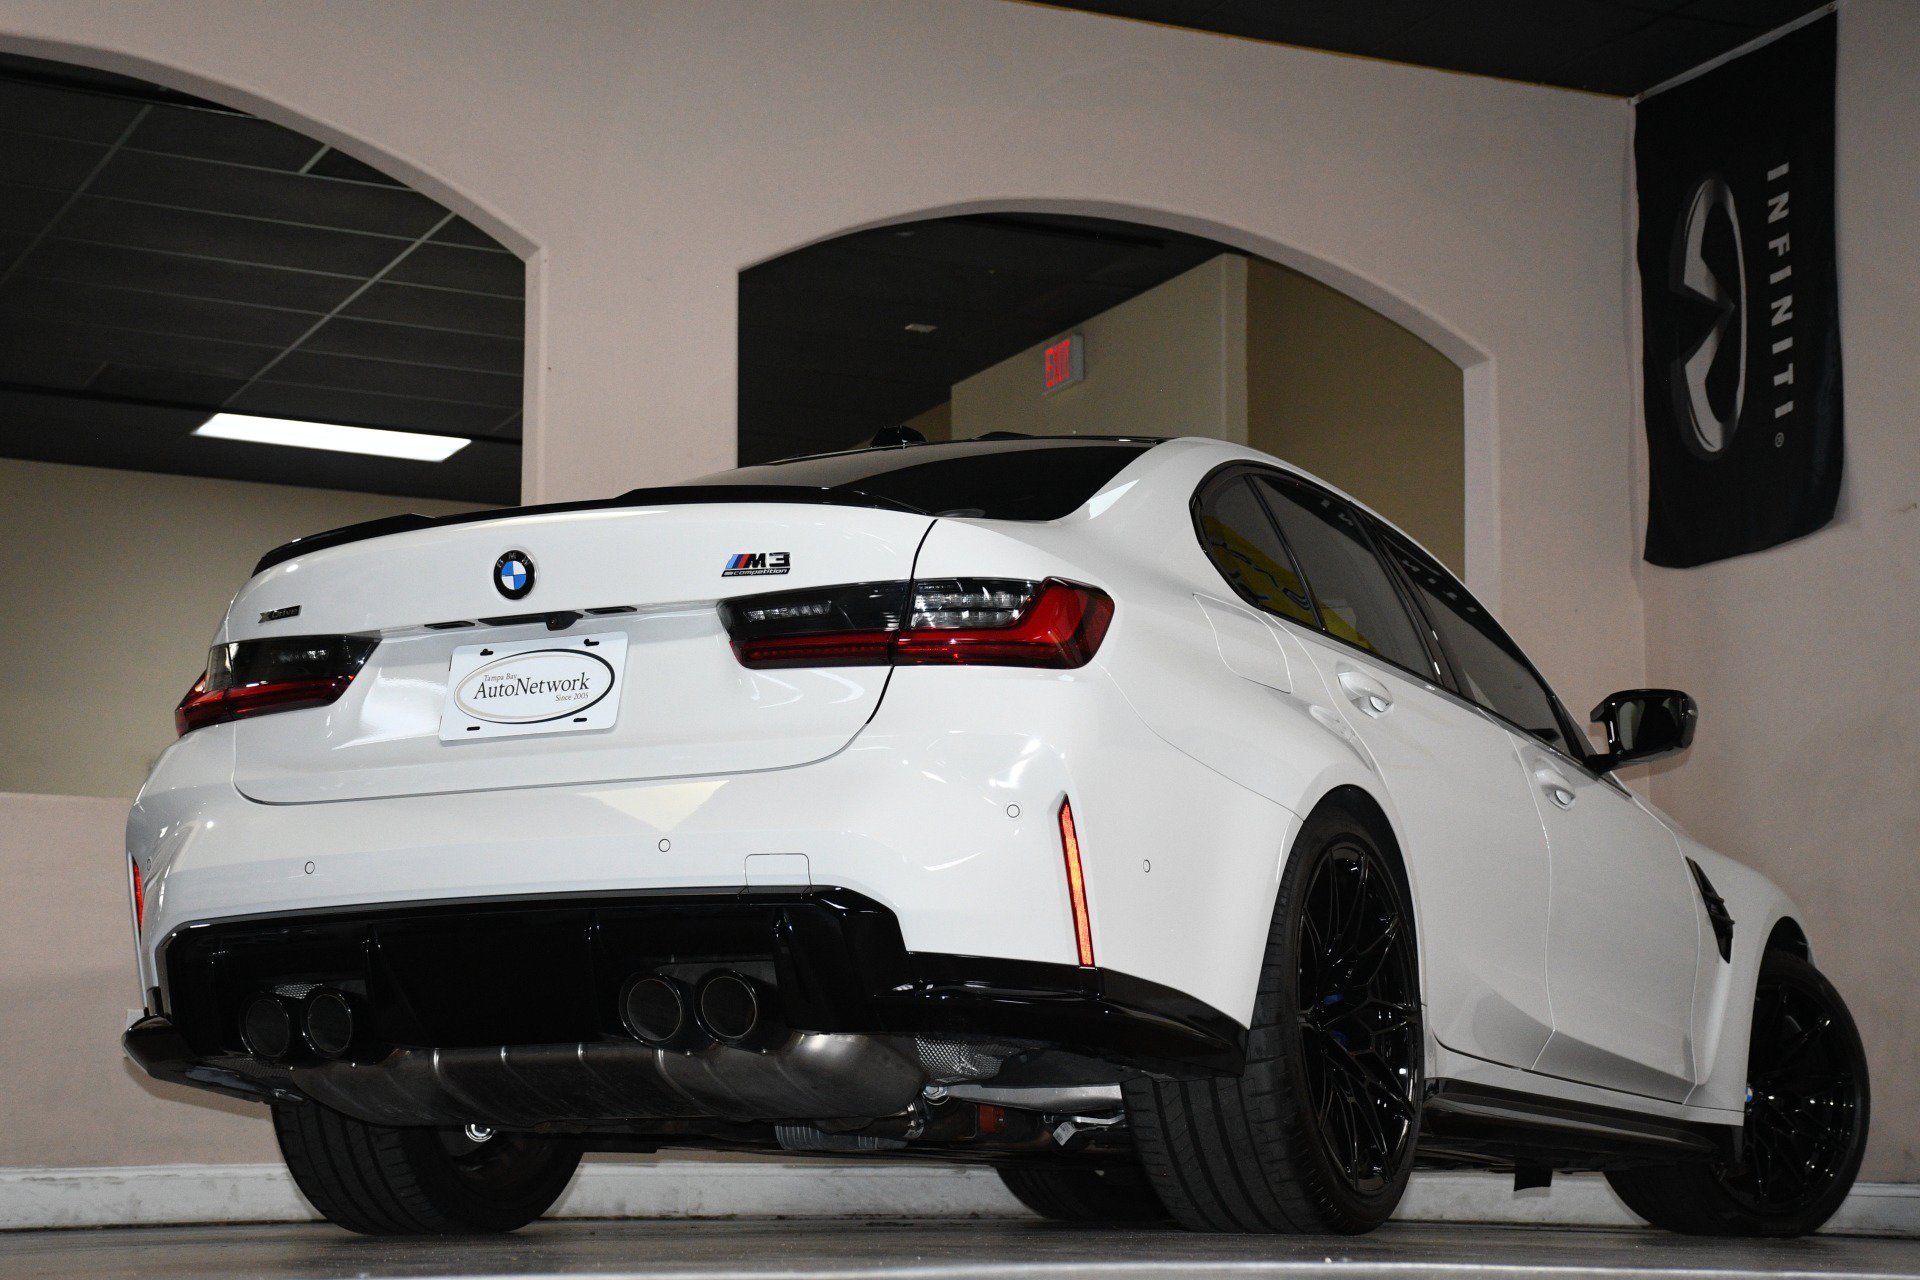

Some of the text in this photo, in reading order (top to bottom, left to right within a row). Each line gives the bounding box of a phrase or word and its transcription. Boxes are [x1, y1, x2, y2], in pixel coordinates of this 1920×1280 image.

[1767, 161, 1794, 419] INFINITI
[1045, 339, 1070, 388] EXIT
[743, 552, 791, 568] M3
[473, 672, 590, 699] AutoNetwork
[484, 673, 518, 682] Tampa Bay
[555, 692, 589, 702] Since 2005
